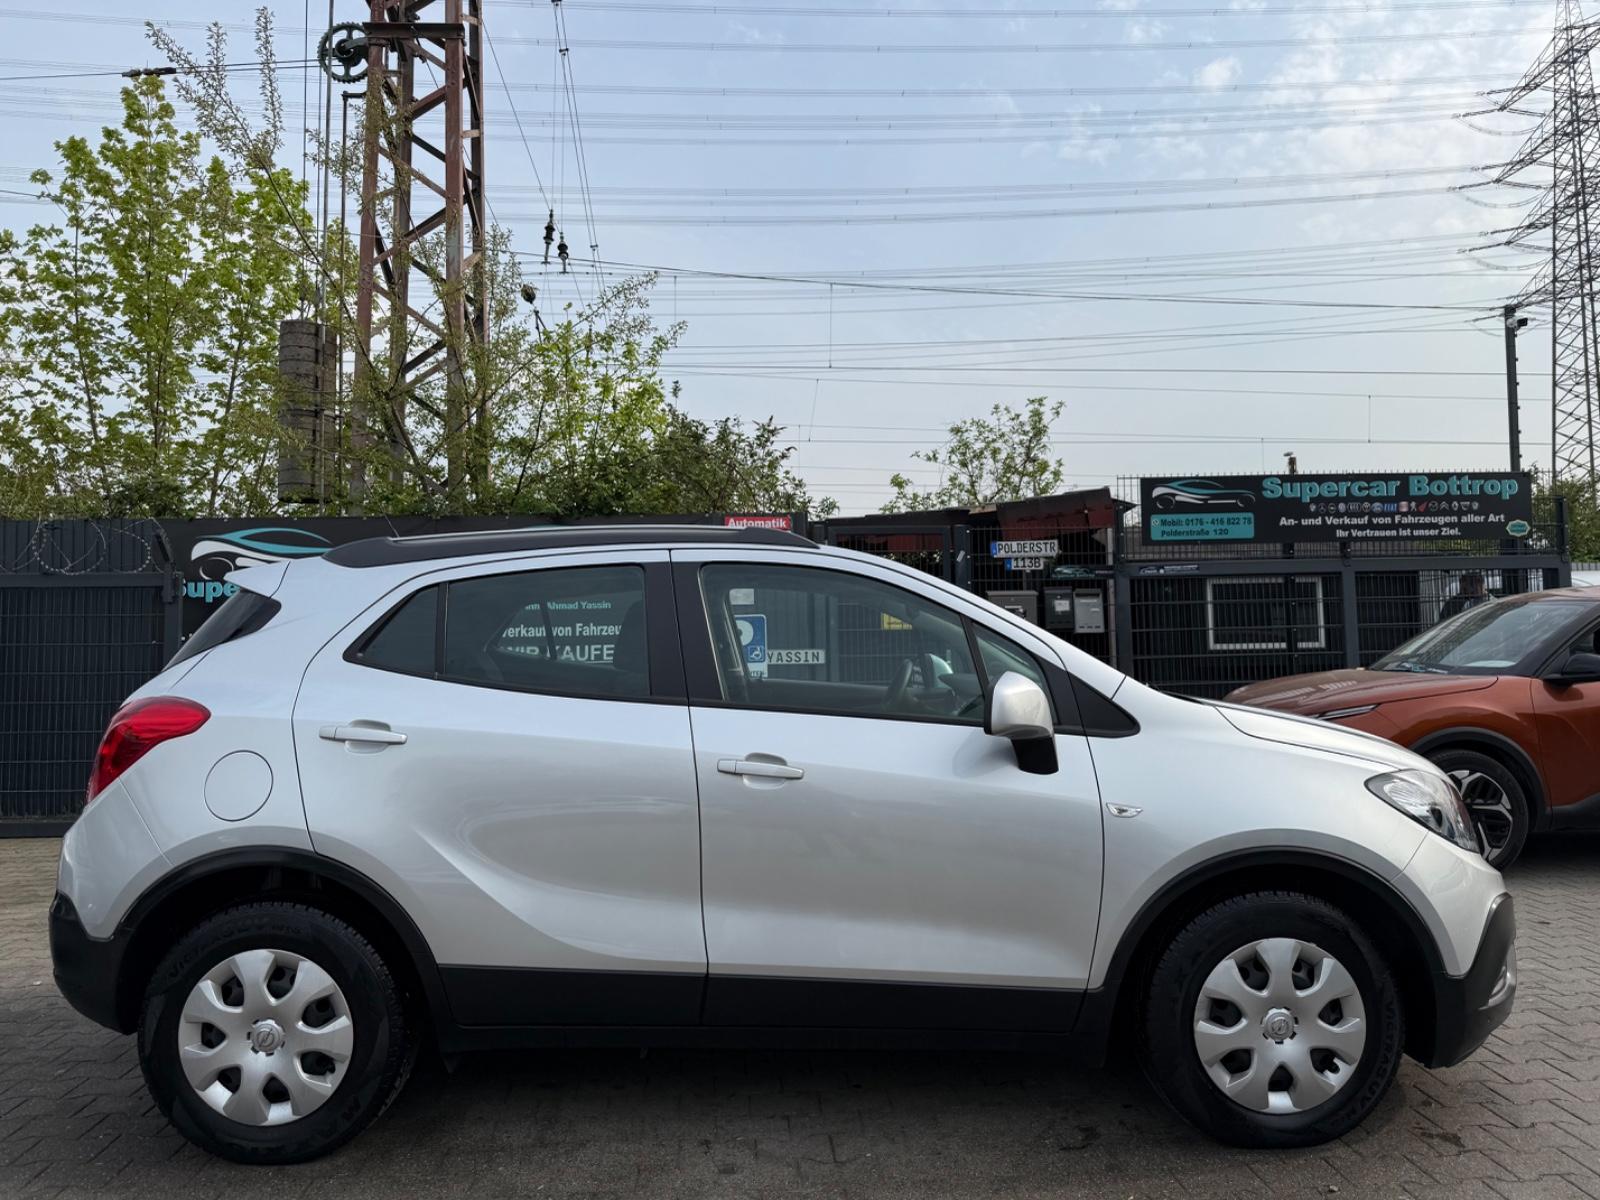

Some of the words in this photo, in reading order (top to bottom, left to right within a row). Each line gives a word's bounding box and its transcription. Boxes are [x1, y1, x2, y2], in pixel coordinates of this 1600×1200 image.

[1262, 477, 1400, 503] Supercar
[1408, 475, 1519, 500] Bottrop
[727, 517, 787, 529] Automatik
[1160, 518, 1183, 527] Mobil:
[1279, 516, 1299, 526] An-
[1301, 516, 1321, 526] und
[1325, 515, 1369, 525] Verkauf
[1371, 516, 1392, 525] von
[1394, 514, 1458, 525] Fahrzeugen
[1460, 513, 1485, 523] aller
[1487, 513, 1505, 523] Art
[1213, 528, 1229, 536] 120
[1335, 529, 1349, 538] Ihr
[1351, 528, 1397, 537] Vertrauen
[1398, 528, 1411, 536] ist
[1413, 528, 1439, 536] unser
[1441, 527, 1462, 536] Ziel.
[997, 541, 1057, 554] POLDERSTR
[1013, 557, 1042, 569] 113B
[580, 601, 612, 609] Yassin
[766, 651, 820, 663] YASSIN
